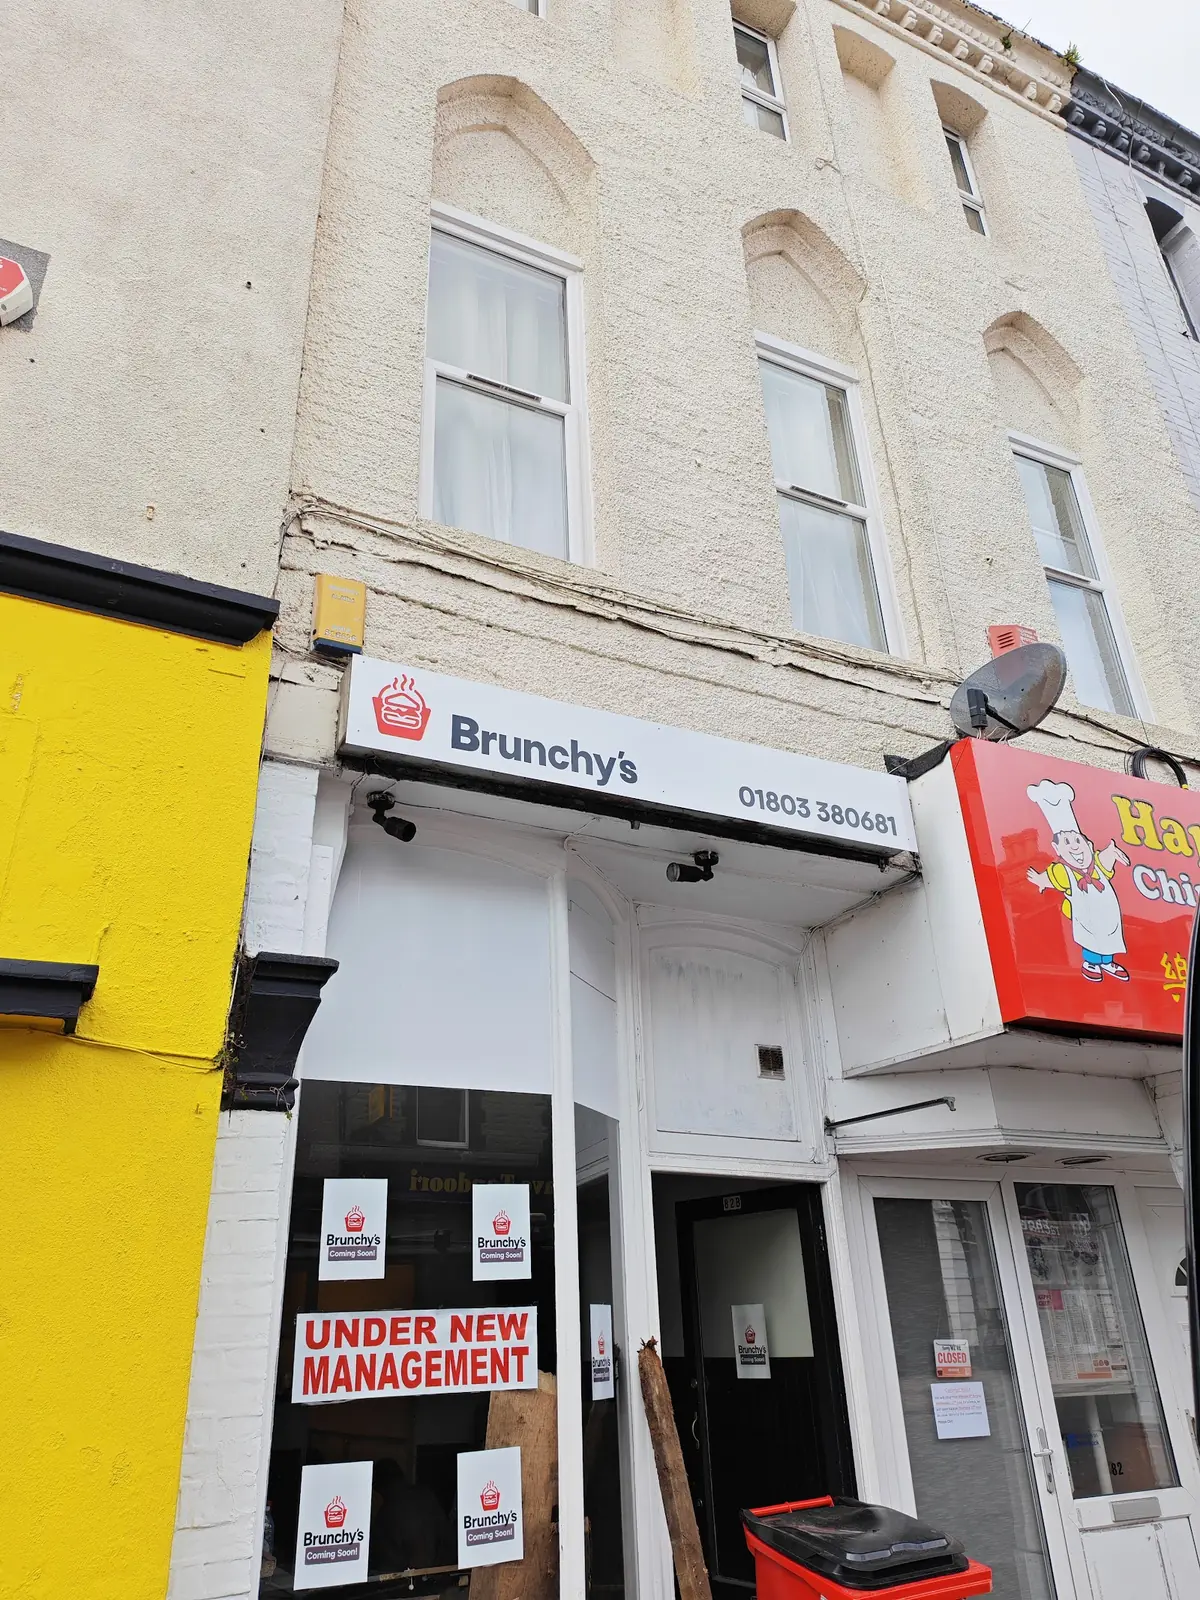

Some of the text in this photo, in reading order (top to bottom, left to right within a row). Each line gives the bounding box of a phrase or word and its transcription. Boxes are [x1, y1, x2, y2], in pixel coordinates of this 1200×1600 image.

[451, 714, 638, 786] Brunchy's
[738, 786, 898, 836] 01803 380681
[1133, 864, 1199, 908] Chi
[326, 1233, 381, 1247] Brunchy's
[477, 1236, 526, 1250] Brunchy's
[329, 1250, 355, 1258] Coming
[480, 1252, 505, 1260] Coming
[305, 1313, 528, 1350] UNDER NEW
[738, 1345, 767, 1354] Brunchy's
[937, 1352, 967, 1364] CLOSED
[302, 1346, 529, 1396] MANAGEMENT
[1111, 1462, 1124, 1476] 82
[463, 1510, 518, 1529] Brunchy's
[303, 1528, 365, 1546] Brunchy's
[467, 1528, 513, 1542] Coming Soon!
[306, 1547, 358, 1560] Coming Soon!
